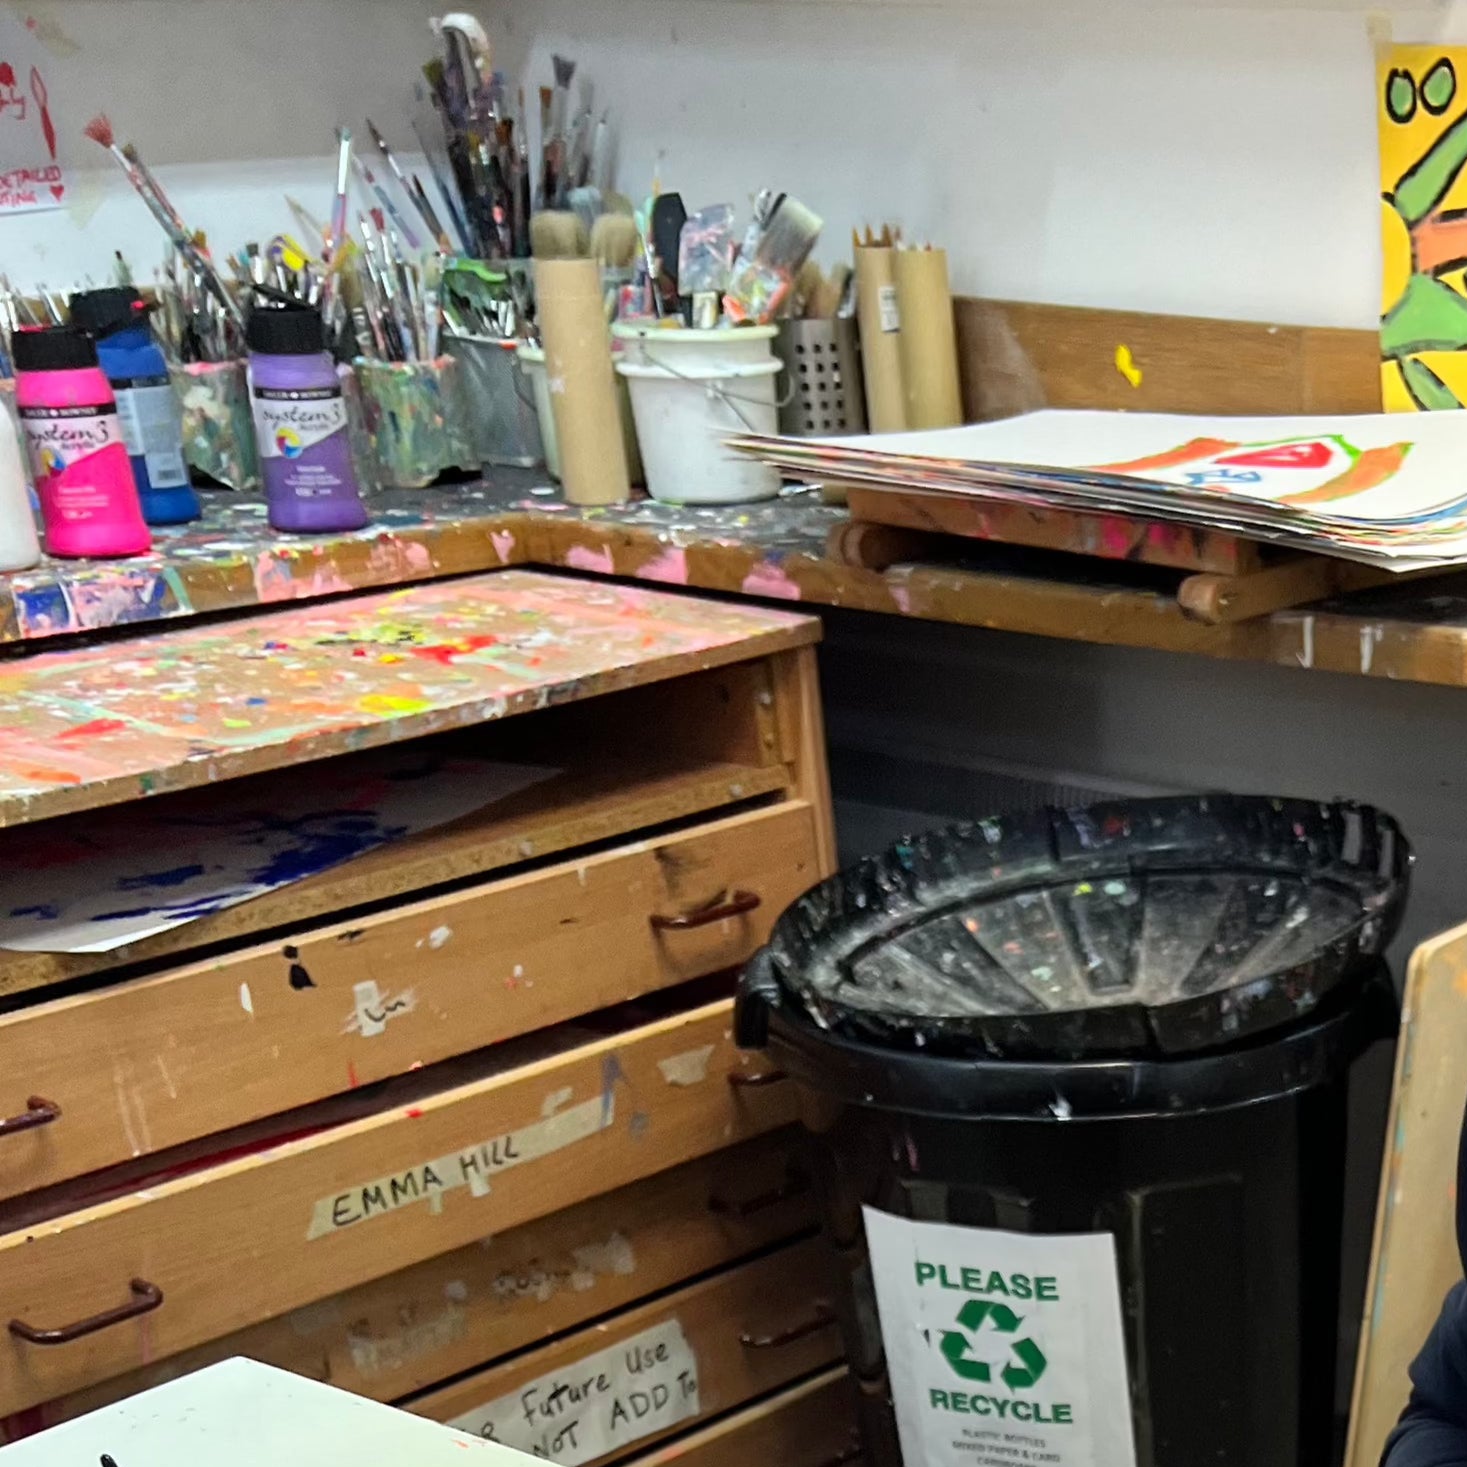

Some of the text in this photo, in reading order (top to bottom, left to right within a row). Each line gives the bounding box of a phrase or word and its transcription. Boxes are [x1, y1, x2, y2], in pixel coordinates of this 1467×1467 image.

[332, 1135, 519, 1227] EMMA HILL
[915, 1261, 1060, 1301] PLEASE
[520, 1343, 670, 1426] Future Use
[610, 1383, 670, 1430] ADD
[929, 1388, 1073, 1424] RECYCLE
